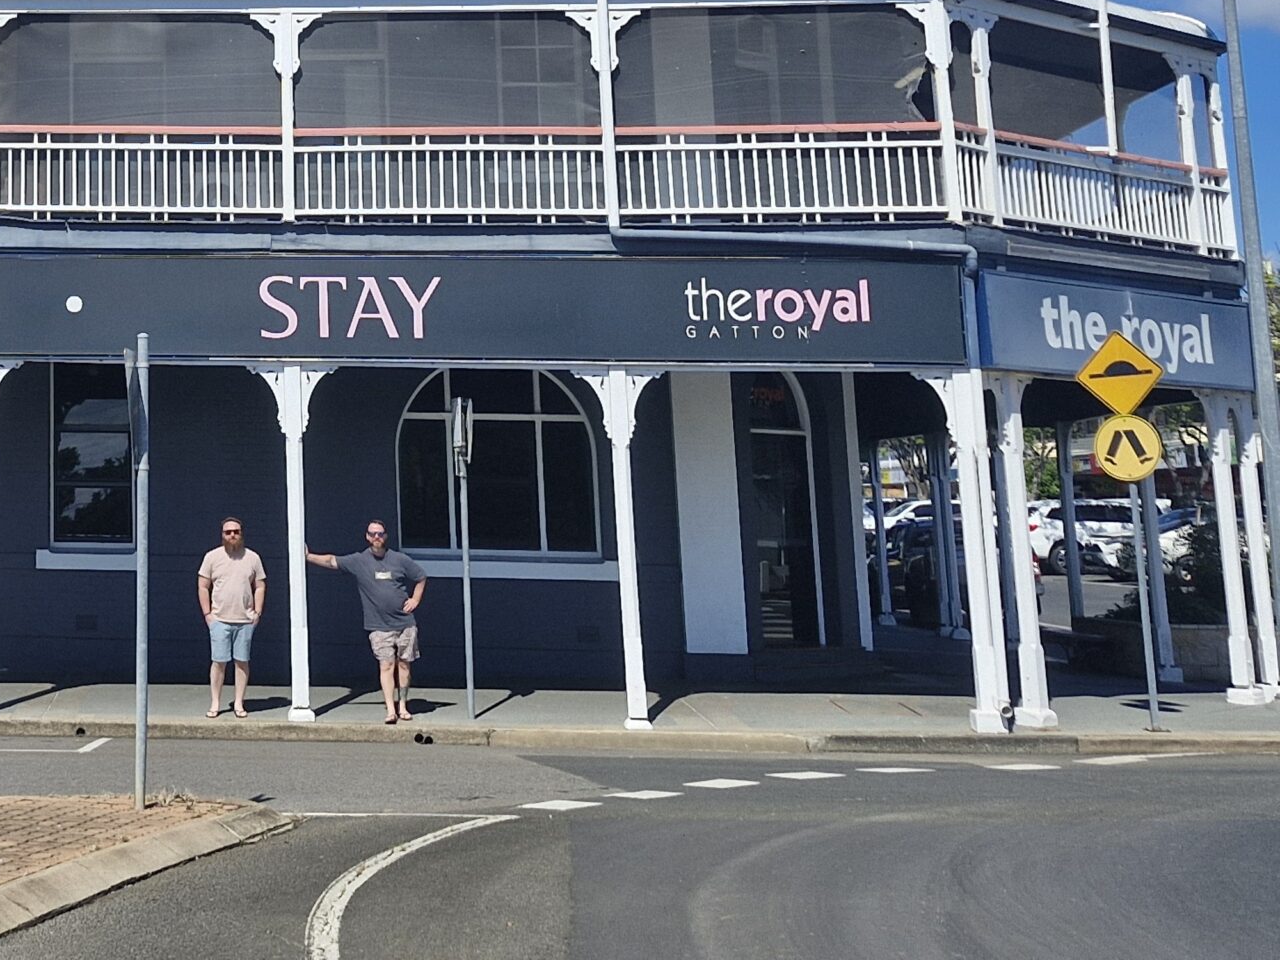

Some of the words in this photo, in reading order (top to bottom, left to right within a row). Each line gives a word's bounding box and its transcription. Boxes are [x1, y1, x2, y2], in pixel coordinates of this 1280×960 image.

[258, 275, 442, 339] STAY
[685, 325, 809, 339] GATTON
[1040, 295, 1108, 352] the
[1120, 313, 1215, 374] royal
